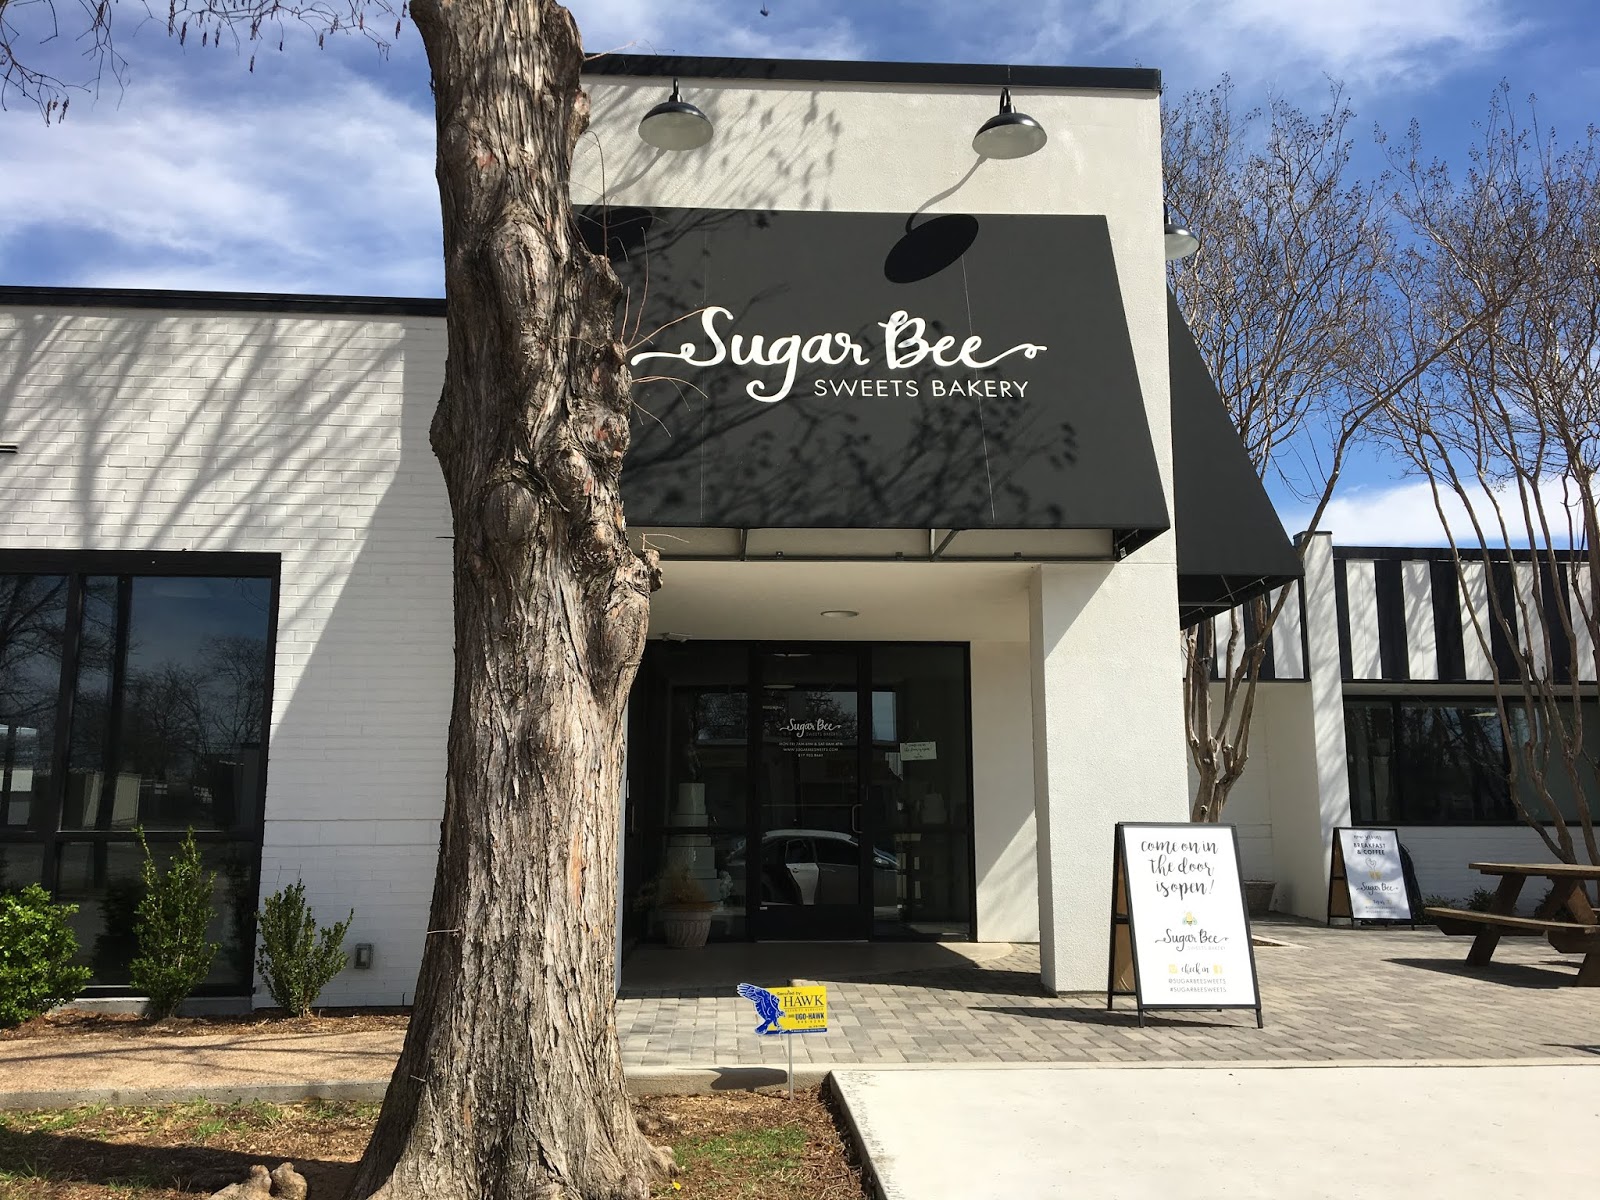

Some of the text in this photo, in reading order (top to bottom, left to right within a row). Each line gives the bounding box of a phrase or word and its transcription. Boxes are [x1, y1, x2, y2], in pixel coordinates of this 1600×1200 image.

[631, 306, 1048, 403] Sugar Bee
[814, 379, 1029, 398] SWEETS BAKERY
[779, 718, 842, 738] Sugar Bee
[1181, 842, 1200, 854] on
[1202, 840, 1219, 854] in
[1178, 857, 1215, 878] door
[1156, 879, 1215, 901] is open!
[1356, 882, 1399, 895] Sugar Bee
[1154, 928, 1230, 952] Sugar Bee
[1181, 962, 1201, 975] check
[783, 994, 824, 1007] HAWK
